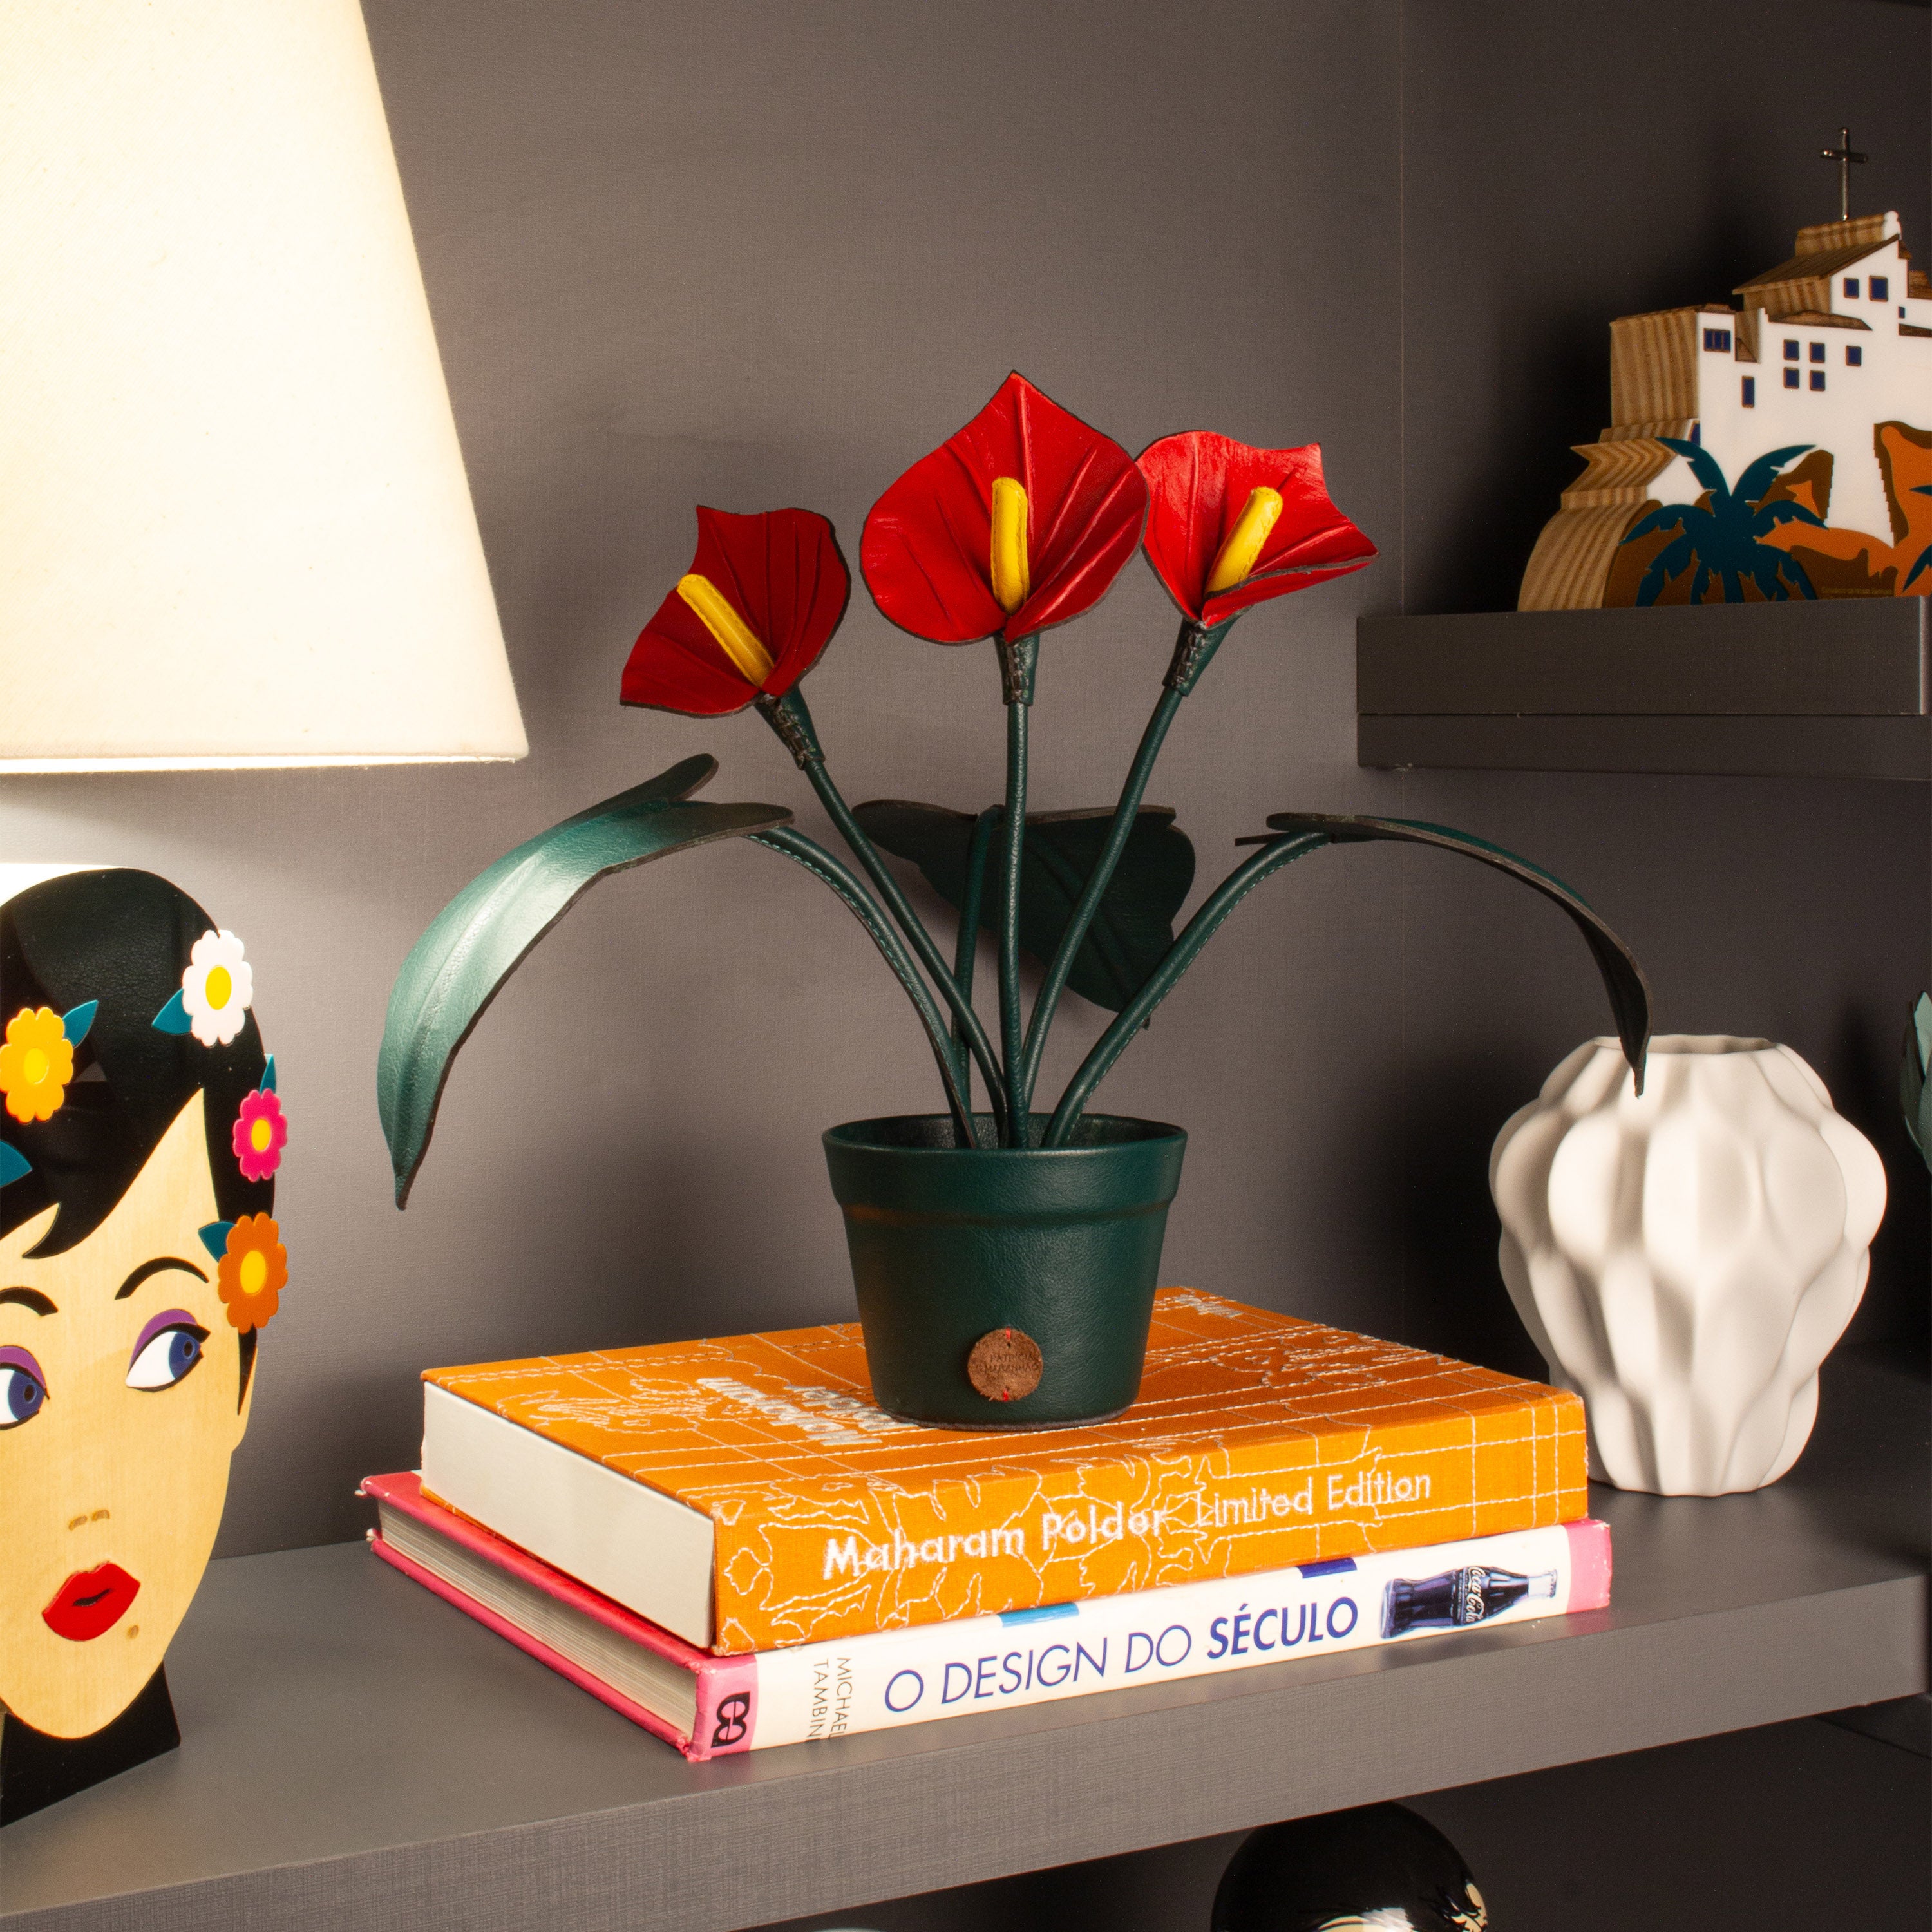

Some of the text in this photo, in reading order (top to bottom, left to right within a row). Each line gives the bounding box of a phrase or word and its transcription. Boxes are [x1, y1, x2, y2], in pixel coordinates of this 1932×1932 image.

[822, 1471, 1432, 1581] Maharam Polder Limited Edition
[808, 1658, 829, 1739] TAMBIN
[828, 1658, 852, 1739] MICHAEL
[884, 1596, 1358, 1713] O DESIGN DO SÉCULO
